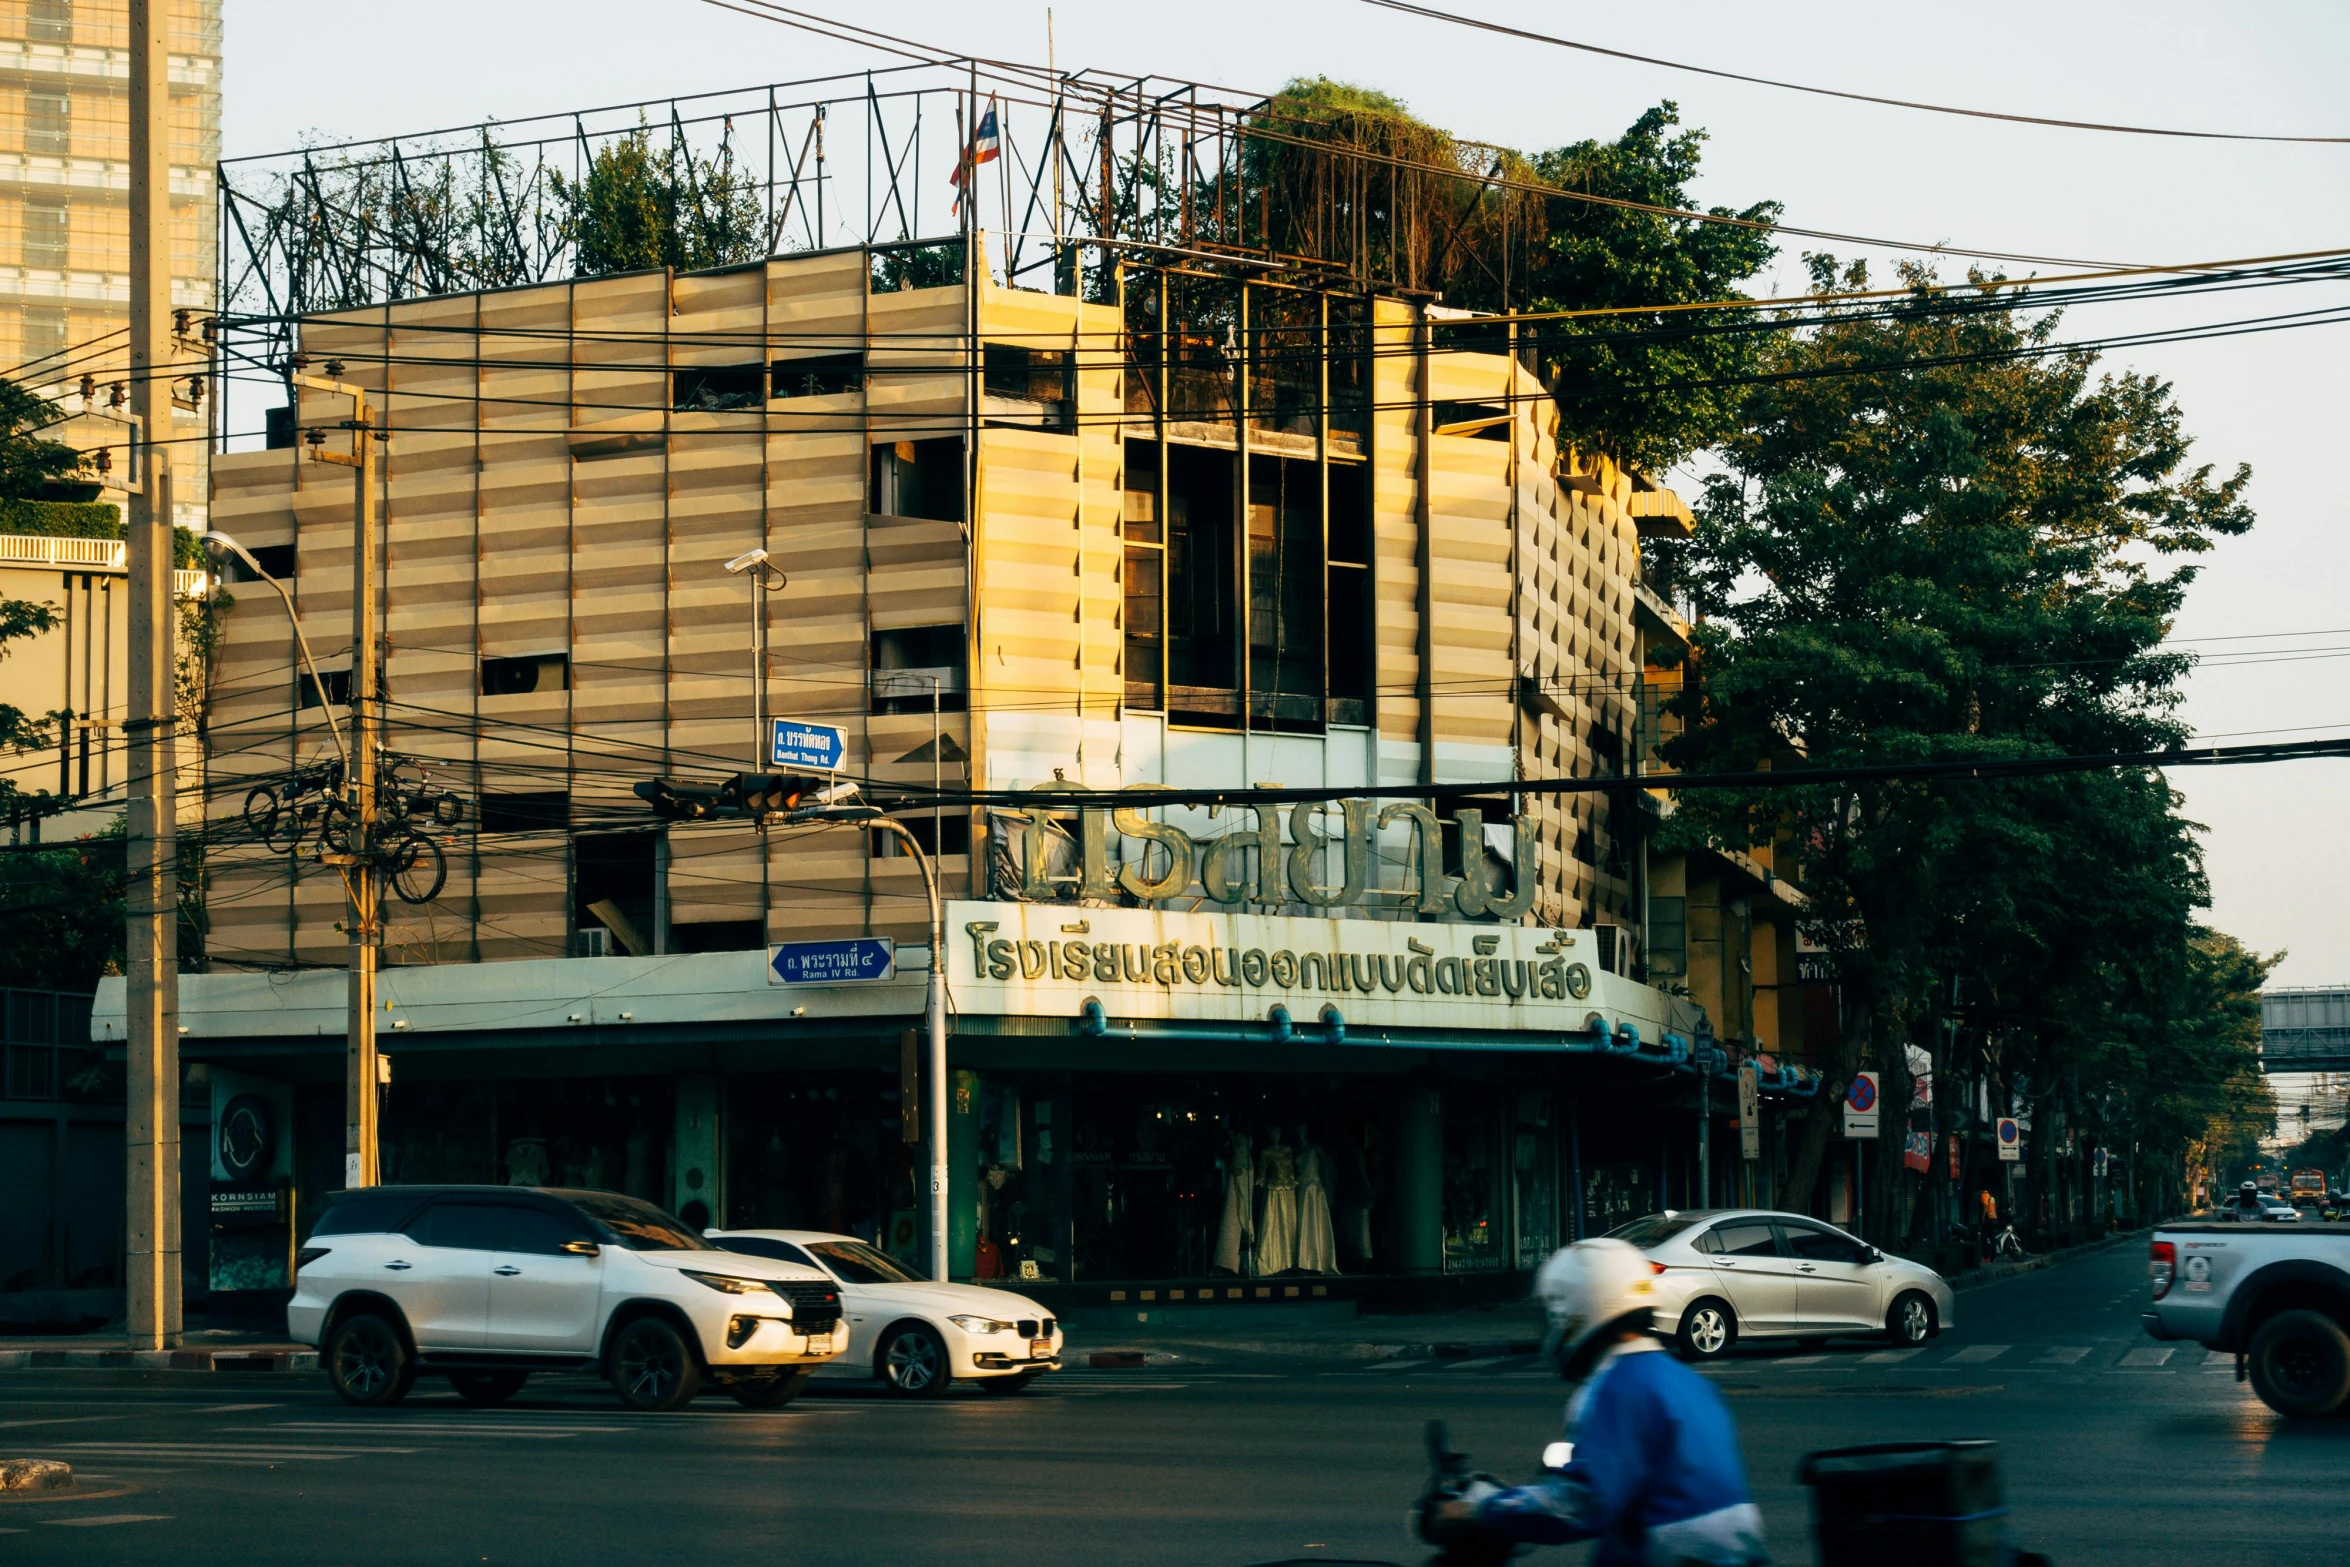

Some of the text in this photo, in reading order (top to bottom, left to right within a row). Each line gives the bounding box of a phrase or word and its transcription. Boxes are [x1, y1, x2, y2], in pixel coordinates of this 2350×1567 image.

[777, 726, 831, 751] ถ. บรรทัดทอง
[776, 749, 830, 765] Banthat Thong Rd.
[1020, 781, 1541, 919] กรสยาม
[787, 942, 875, 969] ถ. พระรามที่ ๔
[965, 919, 1592, 999] โรงเรียนสอนออกแบบตัดเย็บเสื้อ
[802, 969, 860, 979] Rama IV Rd.
[211, 1192, 276, 1202] KORNSIAM
[243, 1204, 276, 1212] INSTITUTE
